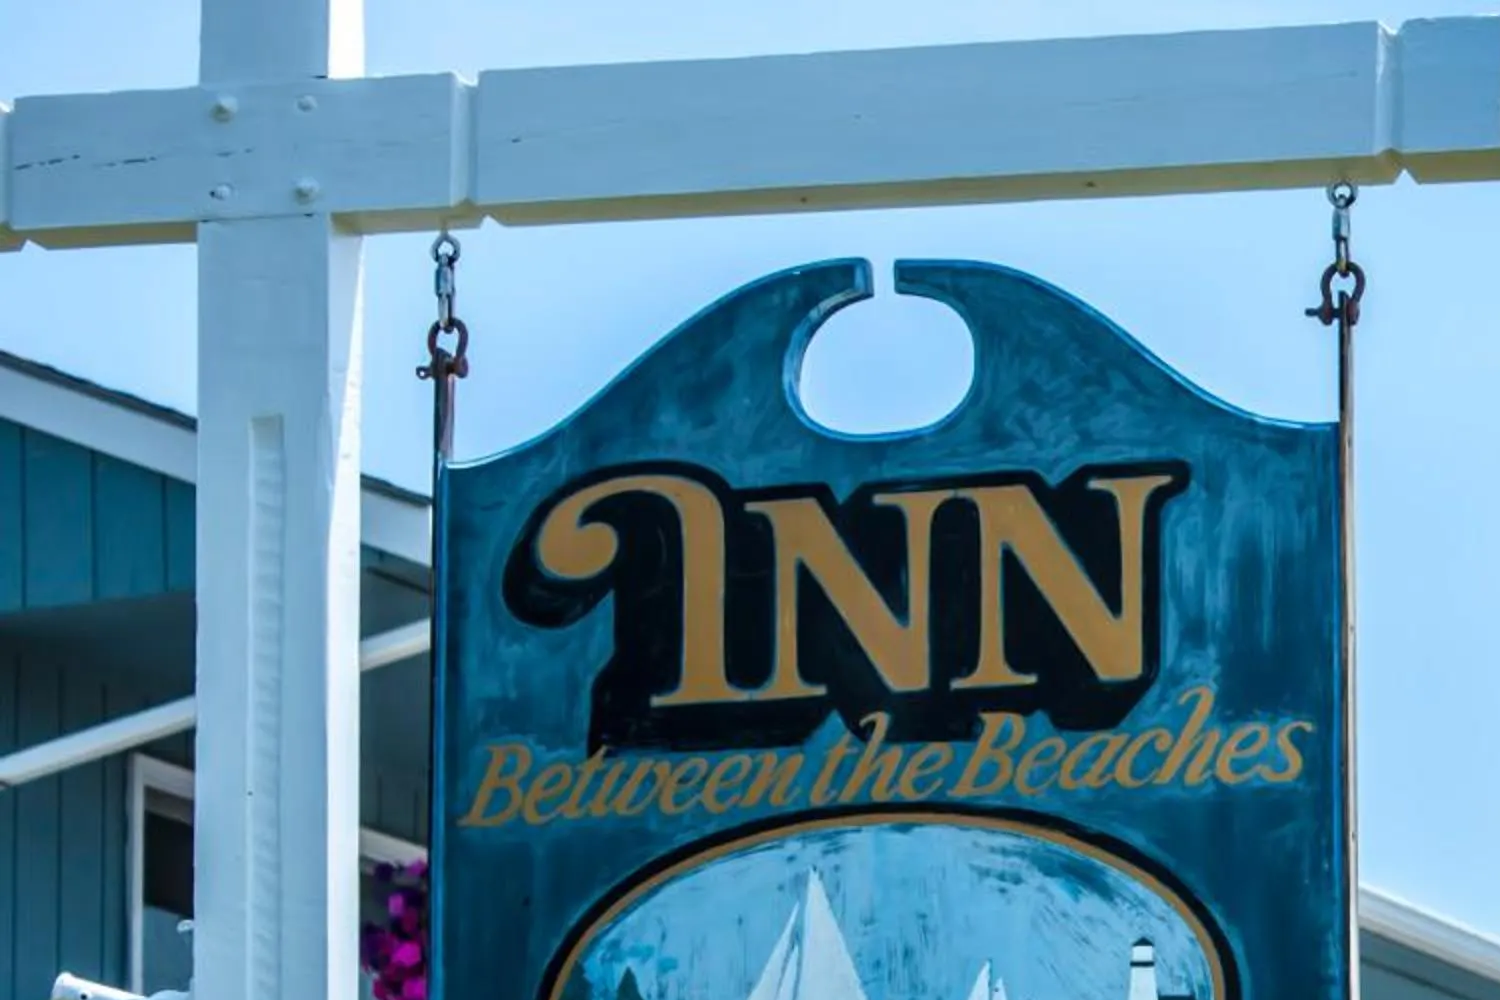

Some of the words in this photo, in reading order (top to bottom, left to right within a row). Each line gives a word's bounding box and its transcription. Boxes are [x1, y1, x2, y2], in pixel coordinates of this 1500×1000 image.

[536, 474, 1176, 708] INN
[457, 743, 808, 829] Between
[808, 710, 954, 803] the
[946, 686, 1315, 800] Beaches
